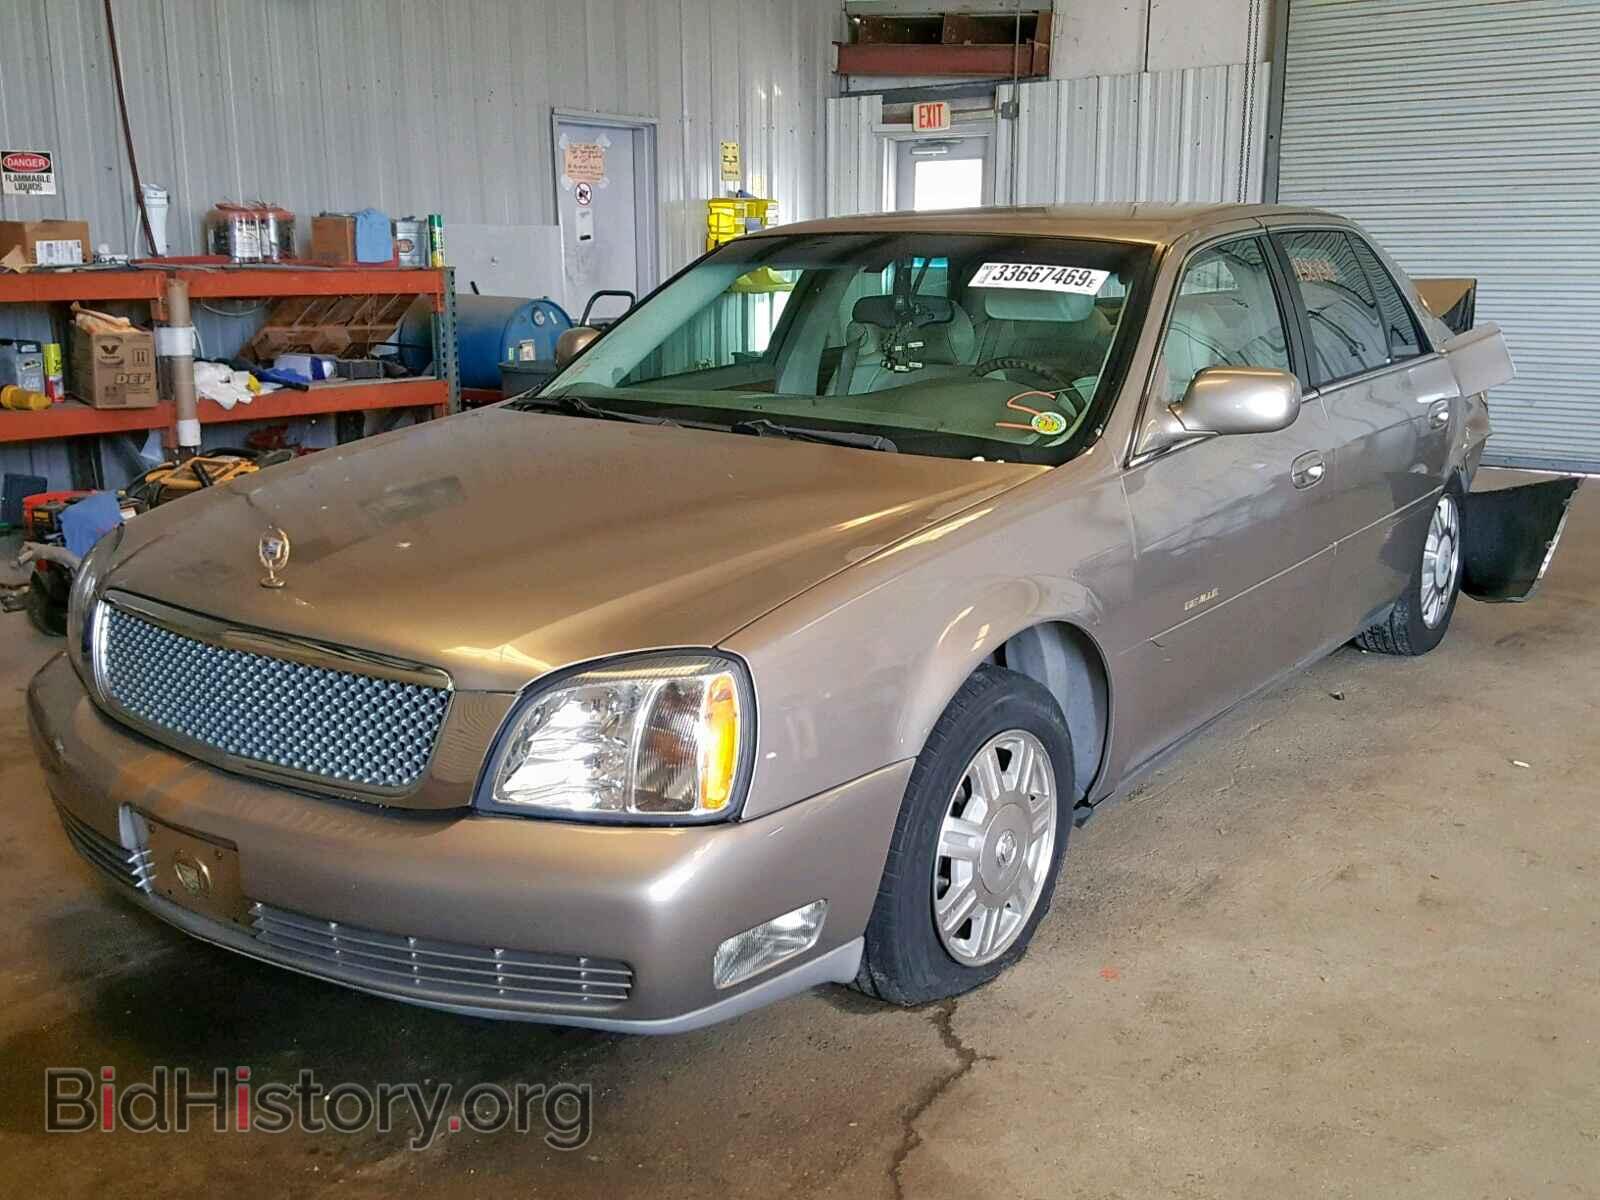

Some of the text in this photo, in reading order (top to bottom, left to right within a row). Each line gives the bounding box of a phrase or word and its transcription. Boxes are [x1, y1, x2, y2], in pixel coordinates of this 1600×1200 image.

[919, 103, 944, 128] EXIT
[7, 157, 46, 168] DANGER
[5, 174, 51, 183] FLAMMABLE
[992, 264, 1092, 287] 33667469
[115, 372, 151, 385] DEF
